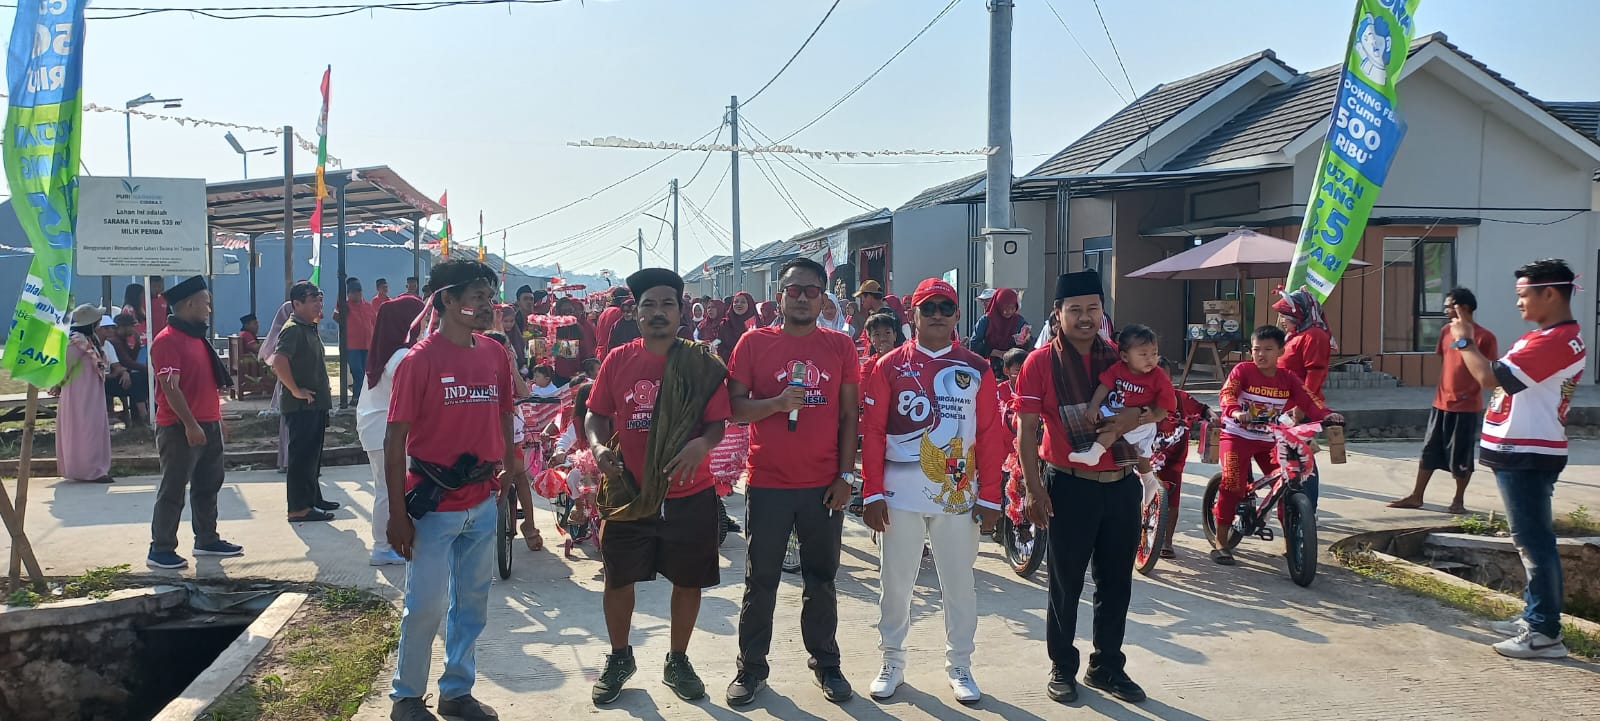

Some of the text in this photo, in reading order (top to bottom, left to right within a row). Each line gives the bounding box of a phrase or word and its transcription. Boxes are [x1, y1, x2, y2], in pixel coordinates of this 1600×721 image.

[1347, 96, 1381, 127] Cuma
[1336, 106, 1380, 151] 500
[1326, 161, 1364, 199] UJAN
[897, 390, 931, 422] 80
[1248, 385, 1290, 398] NDONESIA
